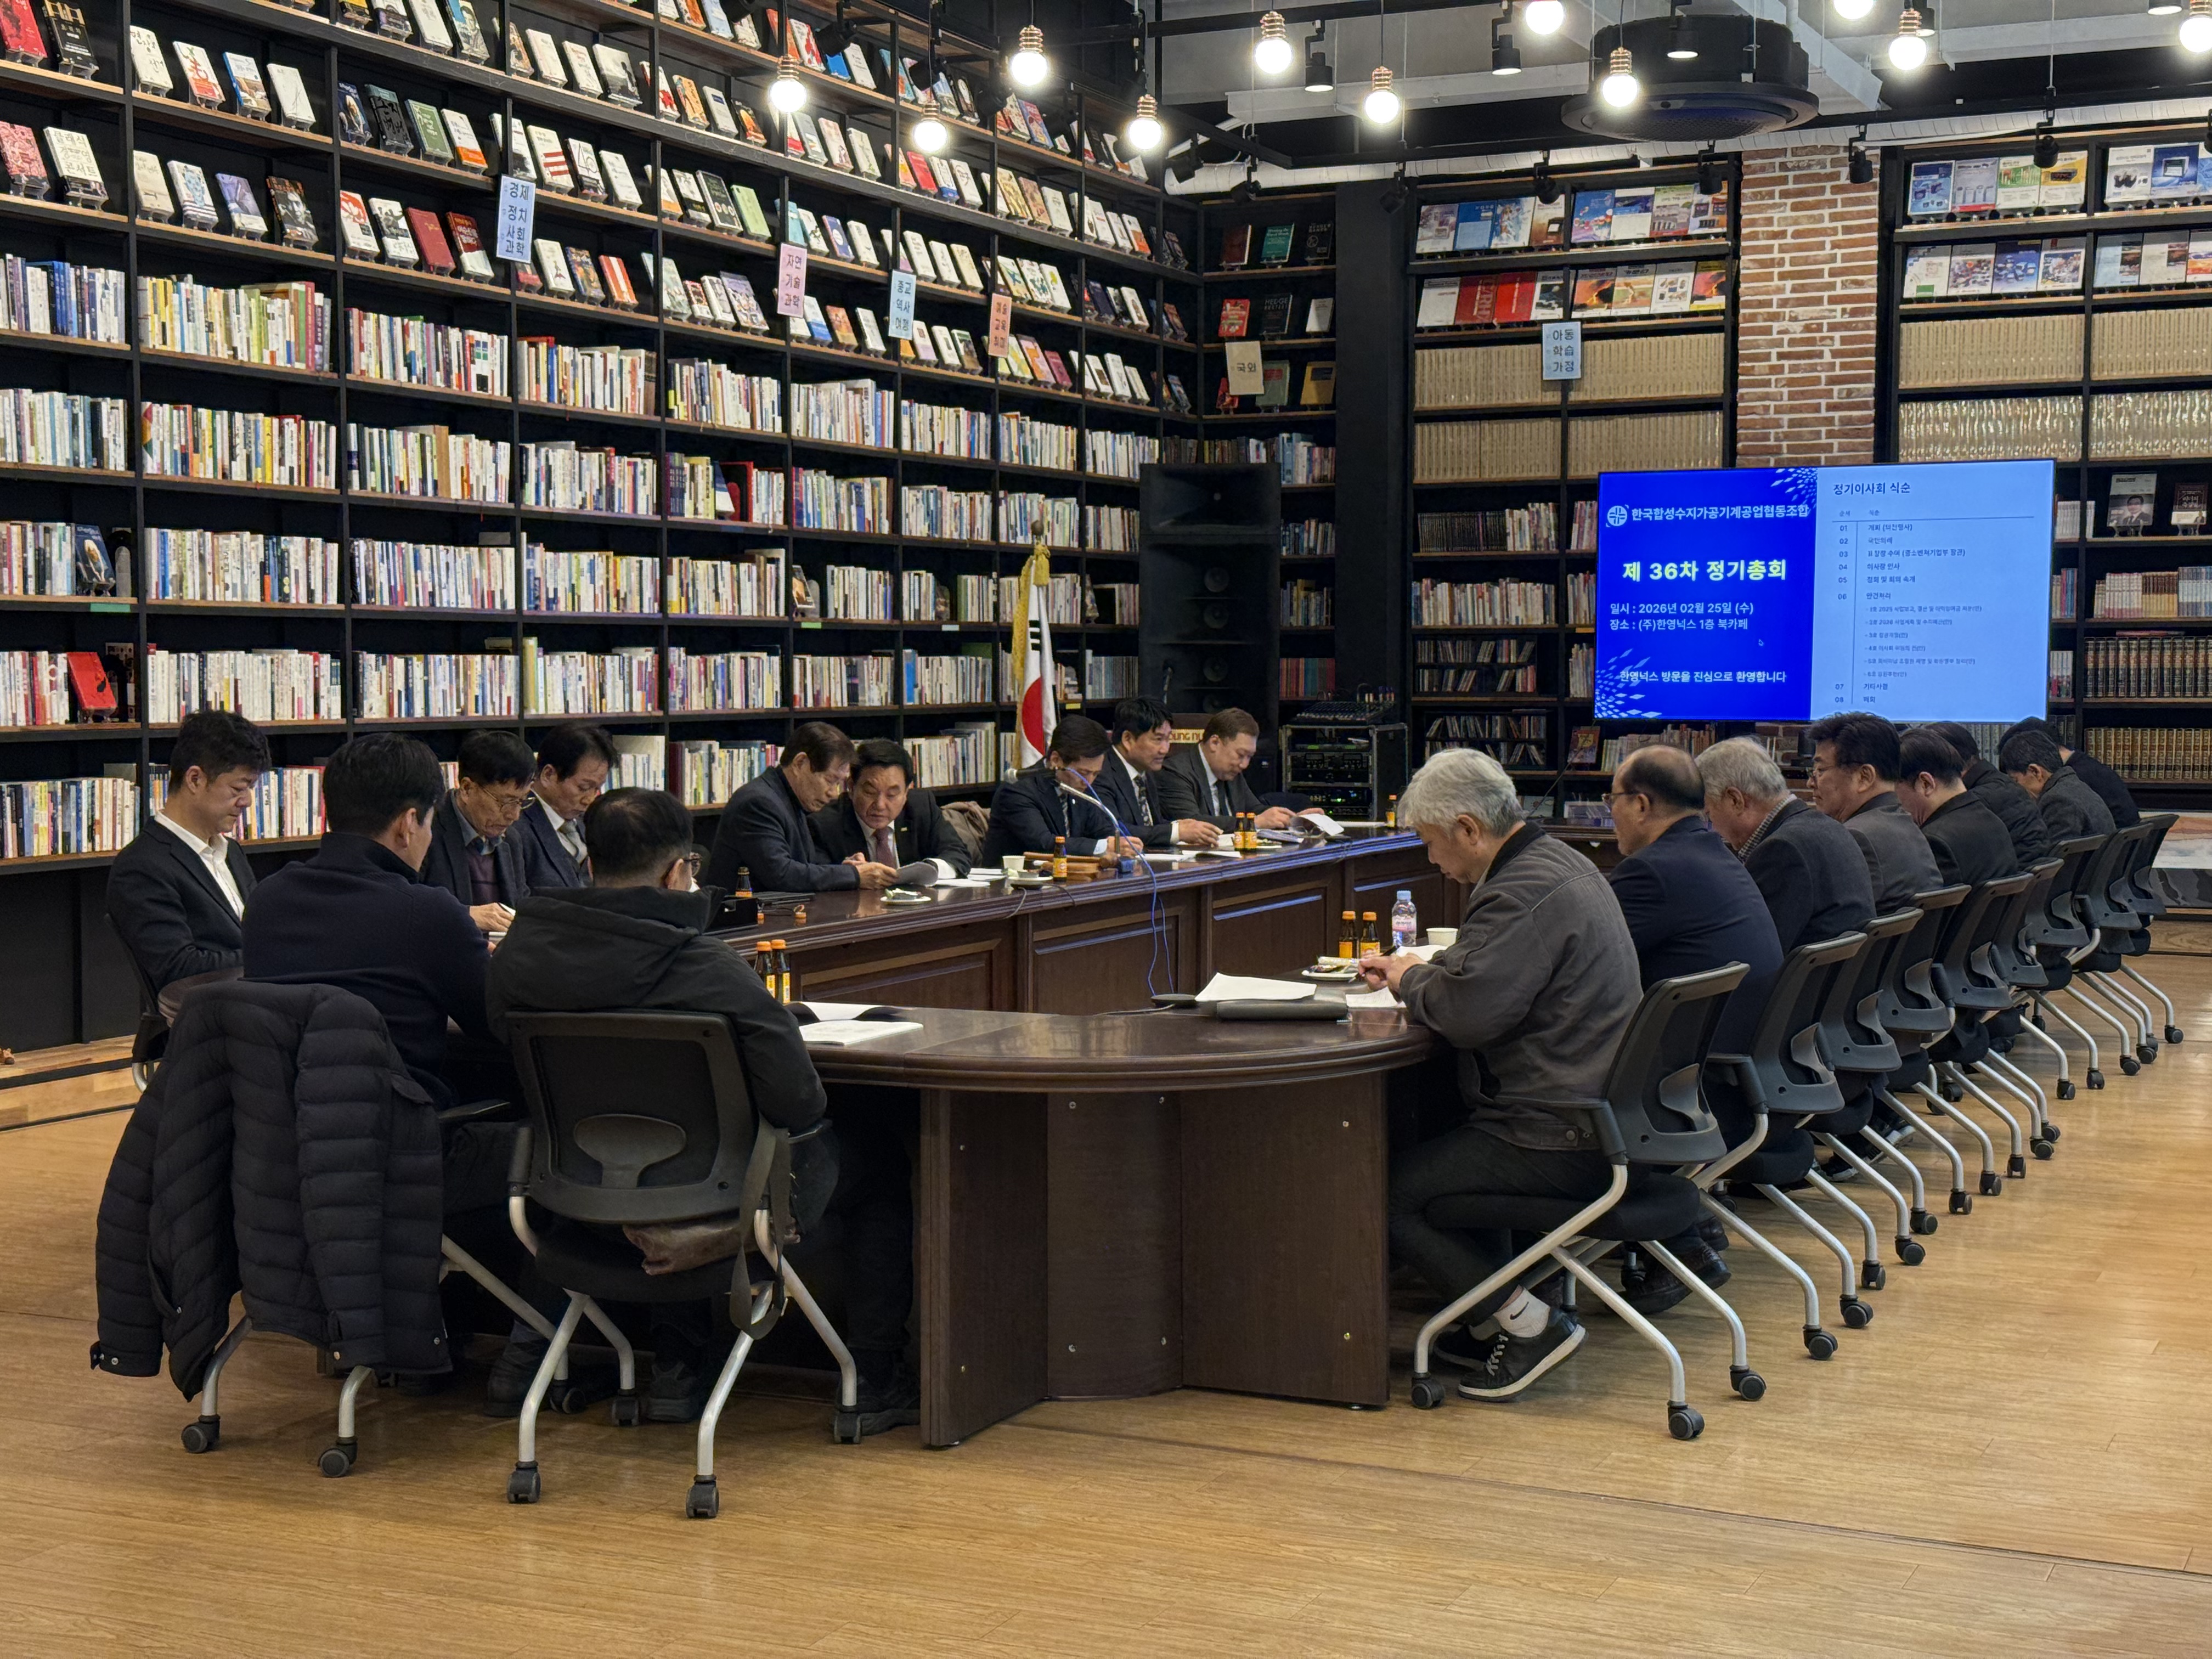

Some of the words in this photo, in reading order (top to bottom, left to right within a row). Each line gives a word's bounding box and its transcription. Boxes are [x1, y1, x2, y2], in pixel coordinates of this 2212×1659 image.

[510, 182, 529, 200] 경제
[507, 205, 527, 223] 정치
[506, 224, 525, 241] 사회
[505, 239, 524, 256] 과학
[786, 254, 802, 269] 자연
[785, 274, 801, 290] 기술
[897, 280, 912, 295] 종교
[896, 298, 911, 313] 역사
[1552, 330, 1575, 341] 아동
[1553, 344, 1575, 357] 학습
[1237, 363, 1256, 373] 국외
[1552, 360, 1575, 373] 가정
[1833, 483, 1885, 495] 정기이사회
[1890, 482, 1910, 493] 식순
[1632, 505, 1809, 521] 한국합성수지가공기계공업협동조합
[1623, 562, 1640, 582] 제
[1650, 561, 1699, 581] 36차
[1707, 560, 1786, 580] 정기총회
[1611, 603, 1629, 614] 일시
[1639, 603, 1676, 614] 2026년
[1680, 602, 1703, 613] 02월
[1708, 602, 1731, 613] 25일
[1735, 602, 1753, 614] (수)
[1610, 619, 1629, 630] 장소
[1700, 619, 1714, 630] 1층
[1718, 618, 1747, 629] 북카페
[1662, 672, 1690, 682] 방문을
[1694, 672, 1733, 682] 진심으로
[1736, 672, 1786, 682] 환영합니다
